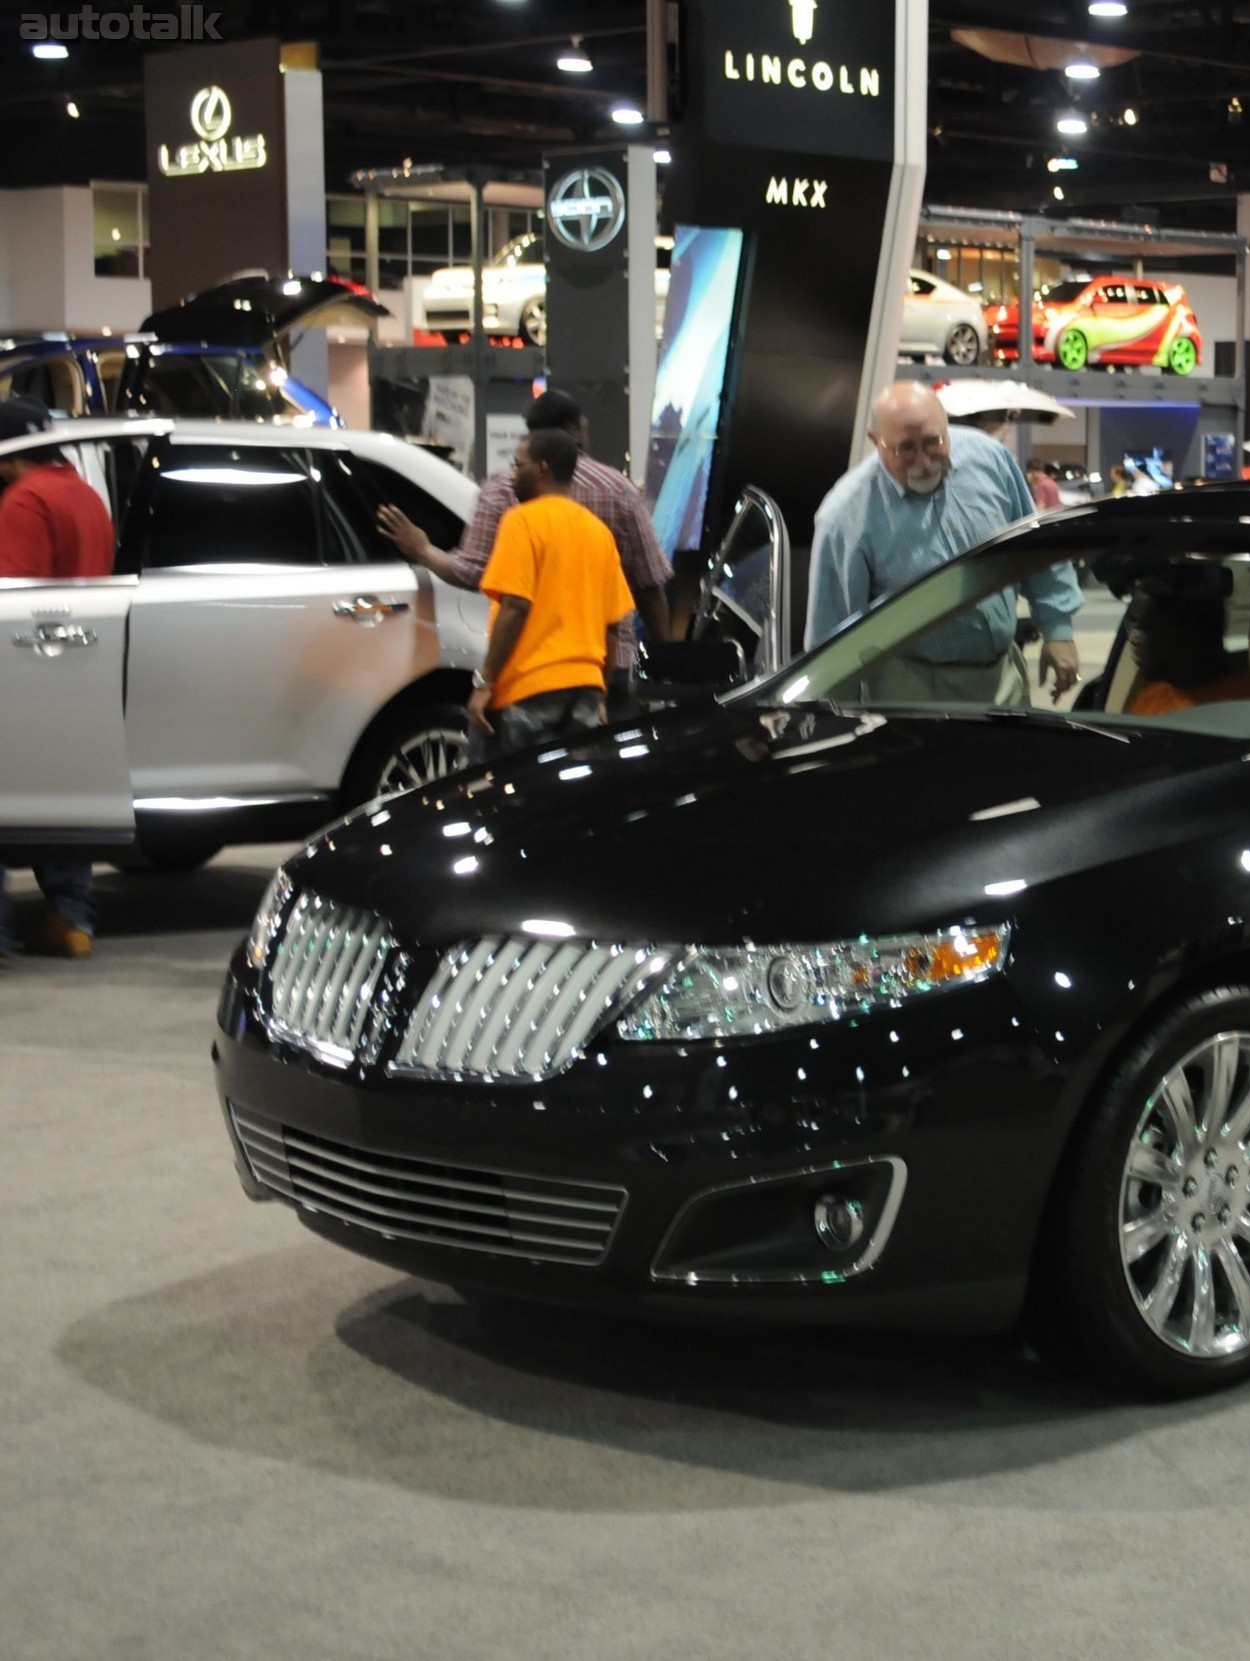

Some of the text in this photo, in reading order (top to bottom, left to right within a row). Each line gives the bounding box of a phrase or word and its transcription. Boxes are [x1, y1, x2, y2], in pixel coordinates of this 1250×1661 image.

[725, 50, 879, 96] LINCOLN
[158, 133, 267, 176] LEXUS
[765, 175, 828, 209] MKX
